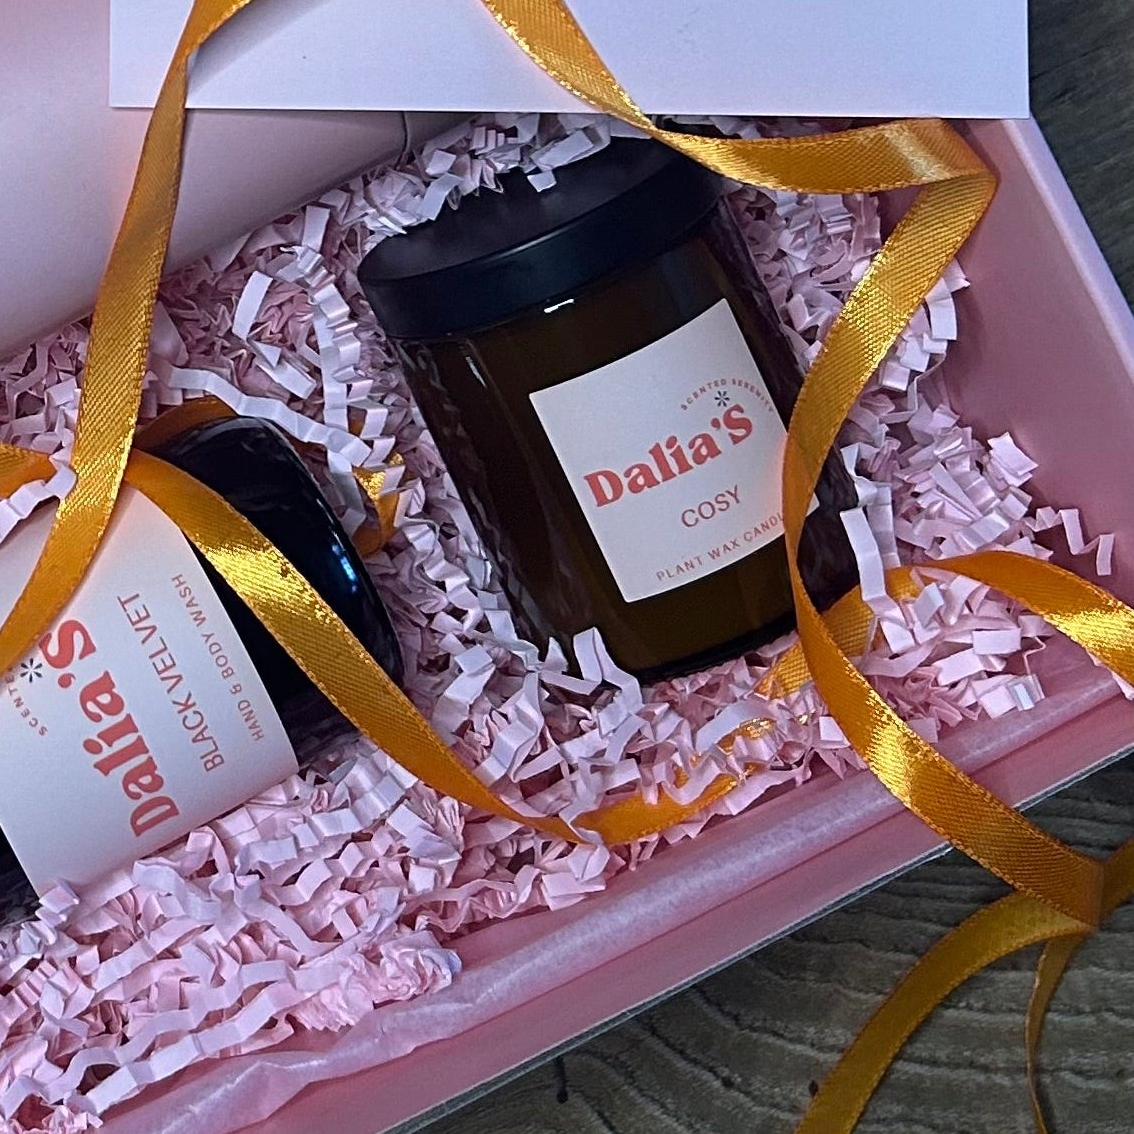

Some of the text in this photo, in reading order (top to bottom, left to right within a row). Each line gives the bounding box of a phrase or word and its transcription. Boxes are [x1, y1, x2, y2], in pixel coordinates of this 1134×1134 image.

[680, 378, 728, 411] SCENTED
[583, 404, 753, 507] Dalia'S
[656, 512, 784, 582] PLANT WAX CANDL
[680, 485, 742, 528] COSY
[117, 592, 225, 772] BLACK VELVET
[171, 572, 264, 741] HAND & BODY WASH
[5, 666, 48, 737] SCENTE
[39, 619, 179, 837] Dalia'S
